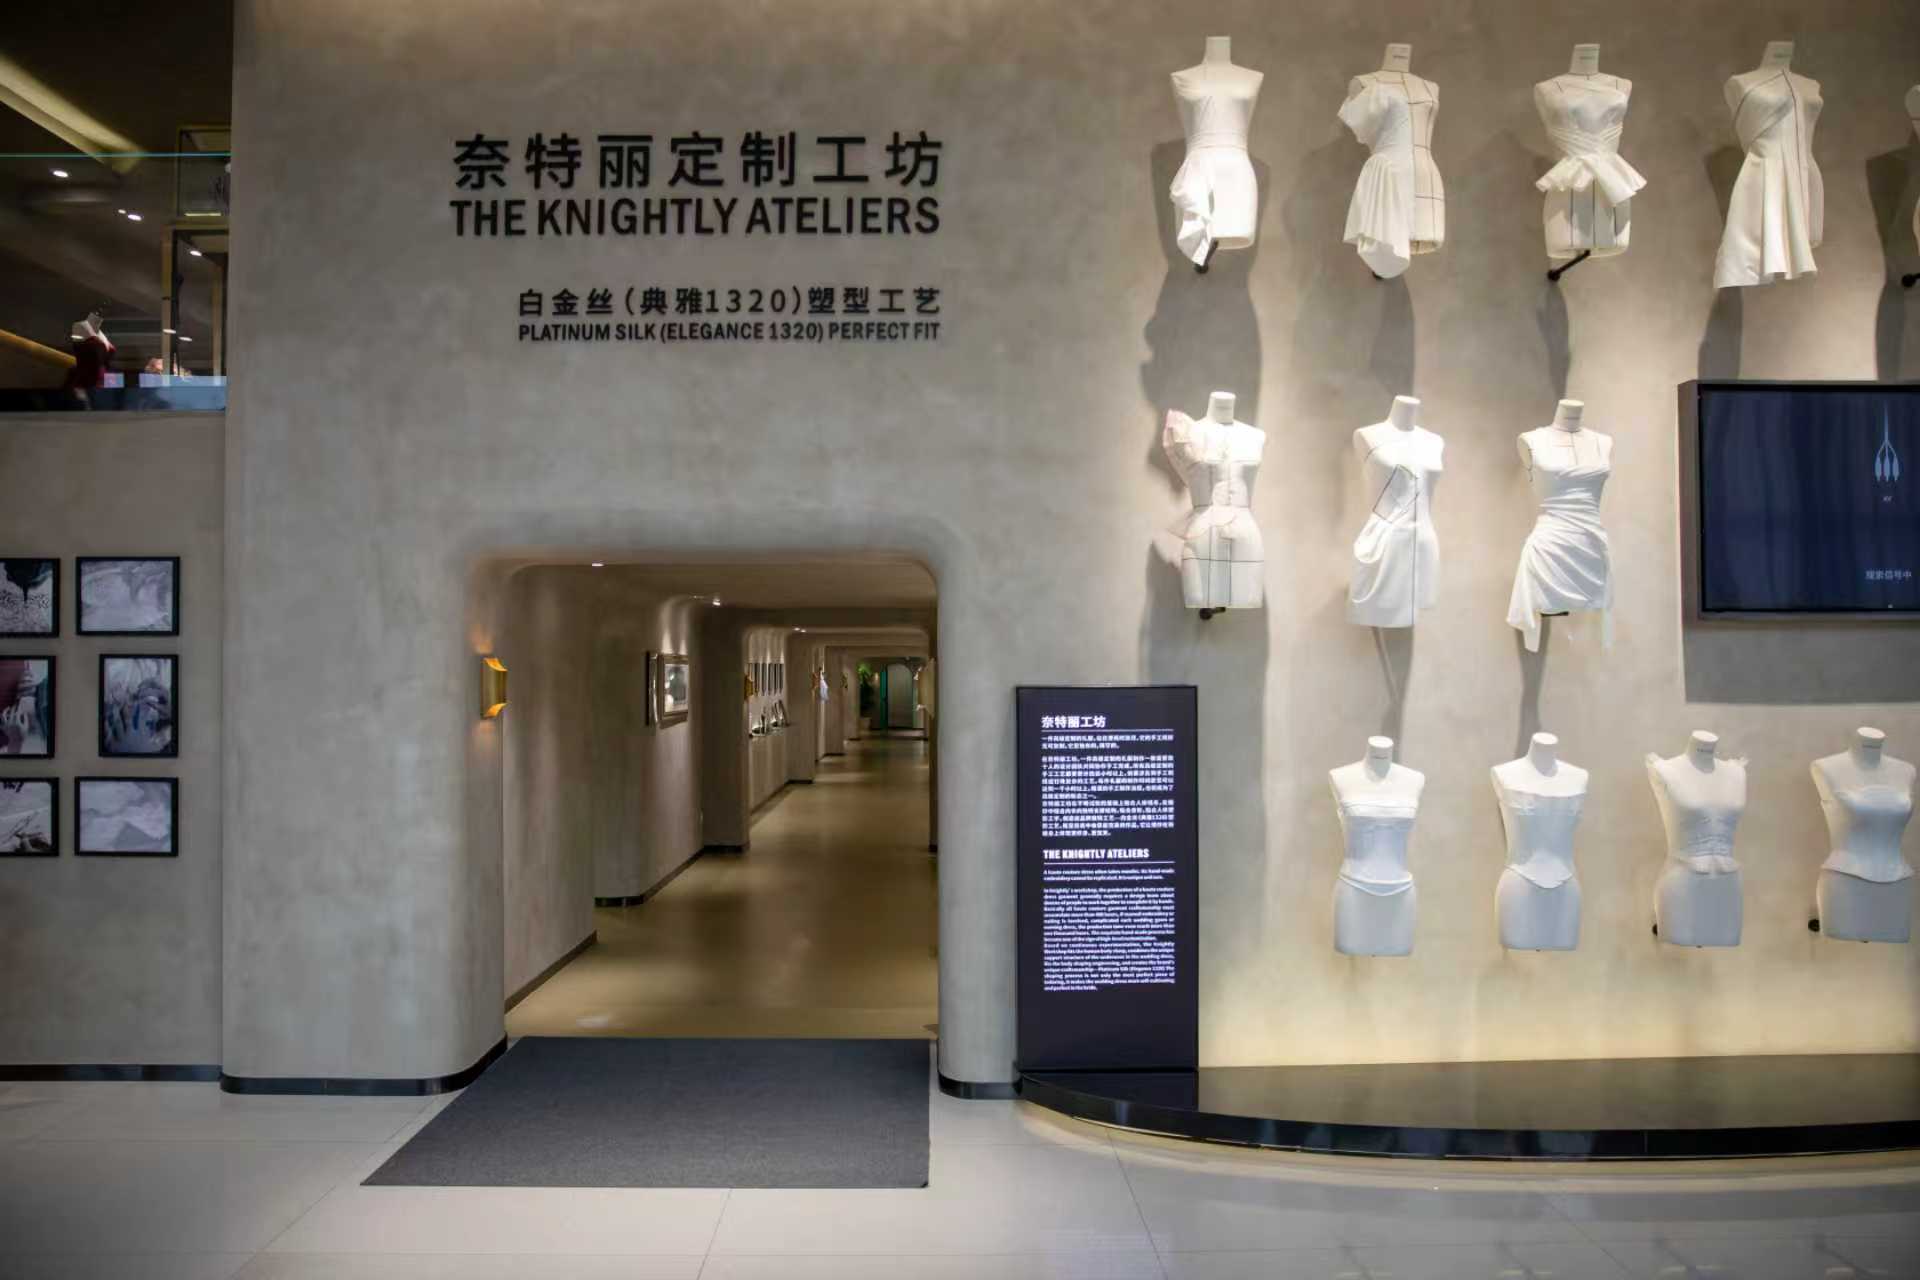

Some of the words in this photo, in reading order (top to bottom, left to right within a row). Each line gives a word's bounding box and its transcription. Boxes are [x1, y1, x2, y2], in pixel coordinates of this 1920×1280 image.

[453, 131, 942, 190] 奈特丽定制工坊
[449, 199, 526, 237] THE
[538, 198, 737, 236] KNIGHTLY
[745, 197, 940, 235] ATELIERS
[519, 323, 610, 342] PLATINUM
[615, 323, 657, 340] SILK
[660, 322, 764, 344] (ELEGANCE
[769, 322, 823, 342] 1320)
[829, 322, 910, 341] PERFECT
[914, 322, 940, 339] FIT
[1041, 715, 1106, 729] 奈特丽工坊
[1043, 849, 1060, 859] THE
[1062, 849, 1106, 859] KNIGHTLY
[1107, 848, 1150, 858] ATELIERS
